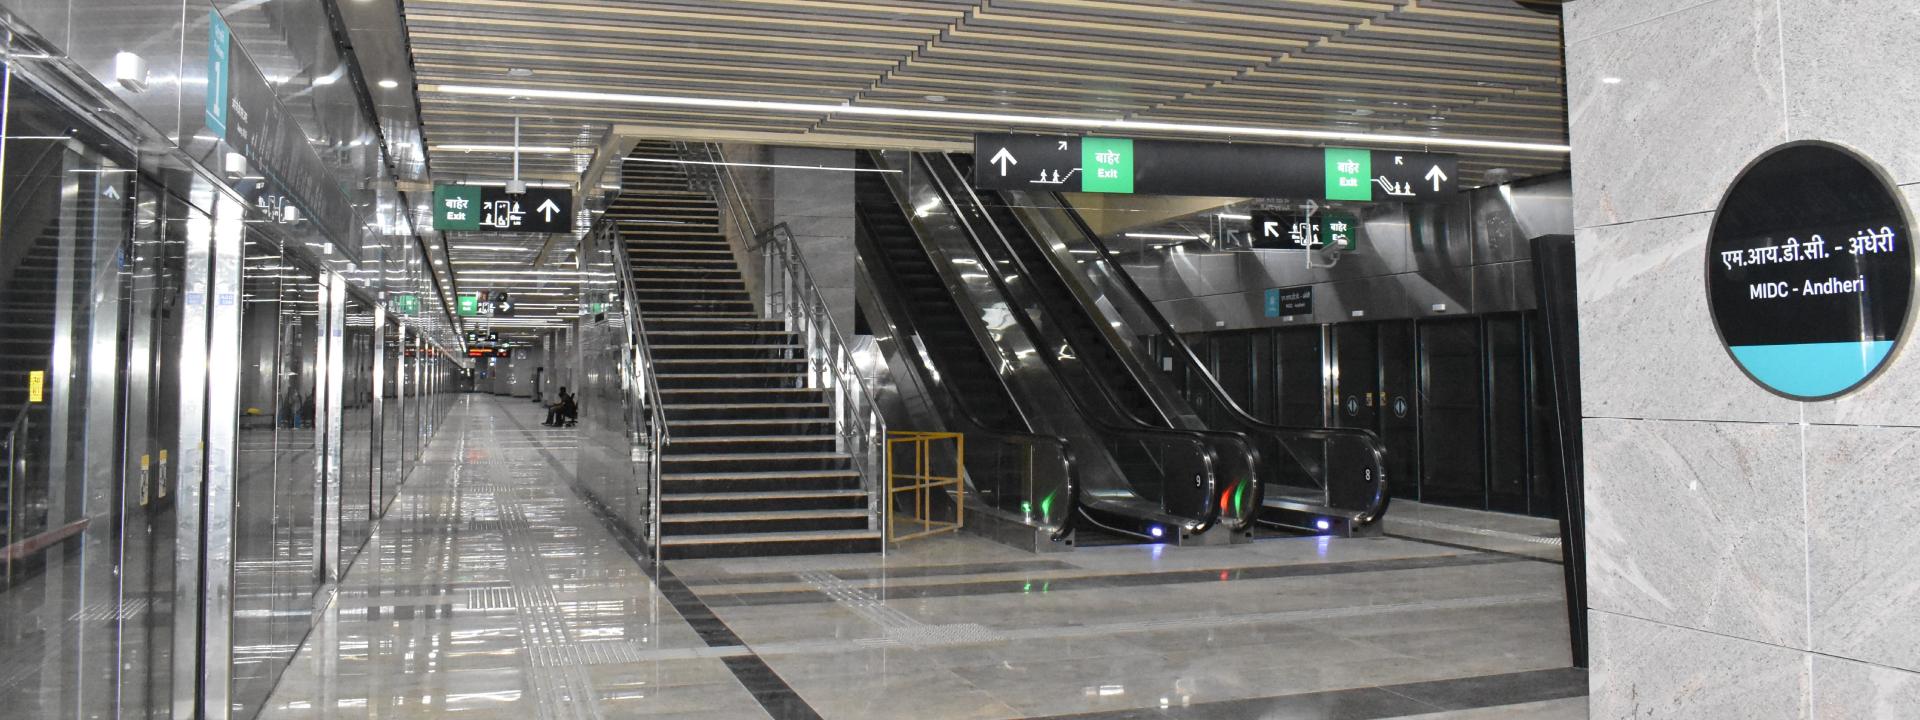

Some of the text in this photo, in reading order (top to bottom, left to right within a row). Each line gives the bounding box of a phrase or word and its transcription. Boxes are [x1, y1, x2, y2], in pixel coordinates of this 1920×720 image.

[213, 61, 221, 118] 1
[1095, 149, 1120, 165] बाहेर
[1097, 168, 1118, 179] Exit
[1339, 176, 1358, 187] Exit
[445, 196, 469, 210] बाहेर
[446, 211, 466, 221] Exit
[1721, 234, 1829, 271] एम.आय.डी.सी.
[1848, 226, 1895, 256] अंधेरी
[1750, 281, 1789, 300] MIDC
[1802, 274, 1865, 297] Andheri
[1195, 474, 1201, 487] 9
[1365, 468, 1371, 481] 8
